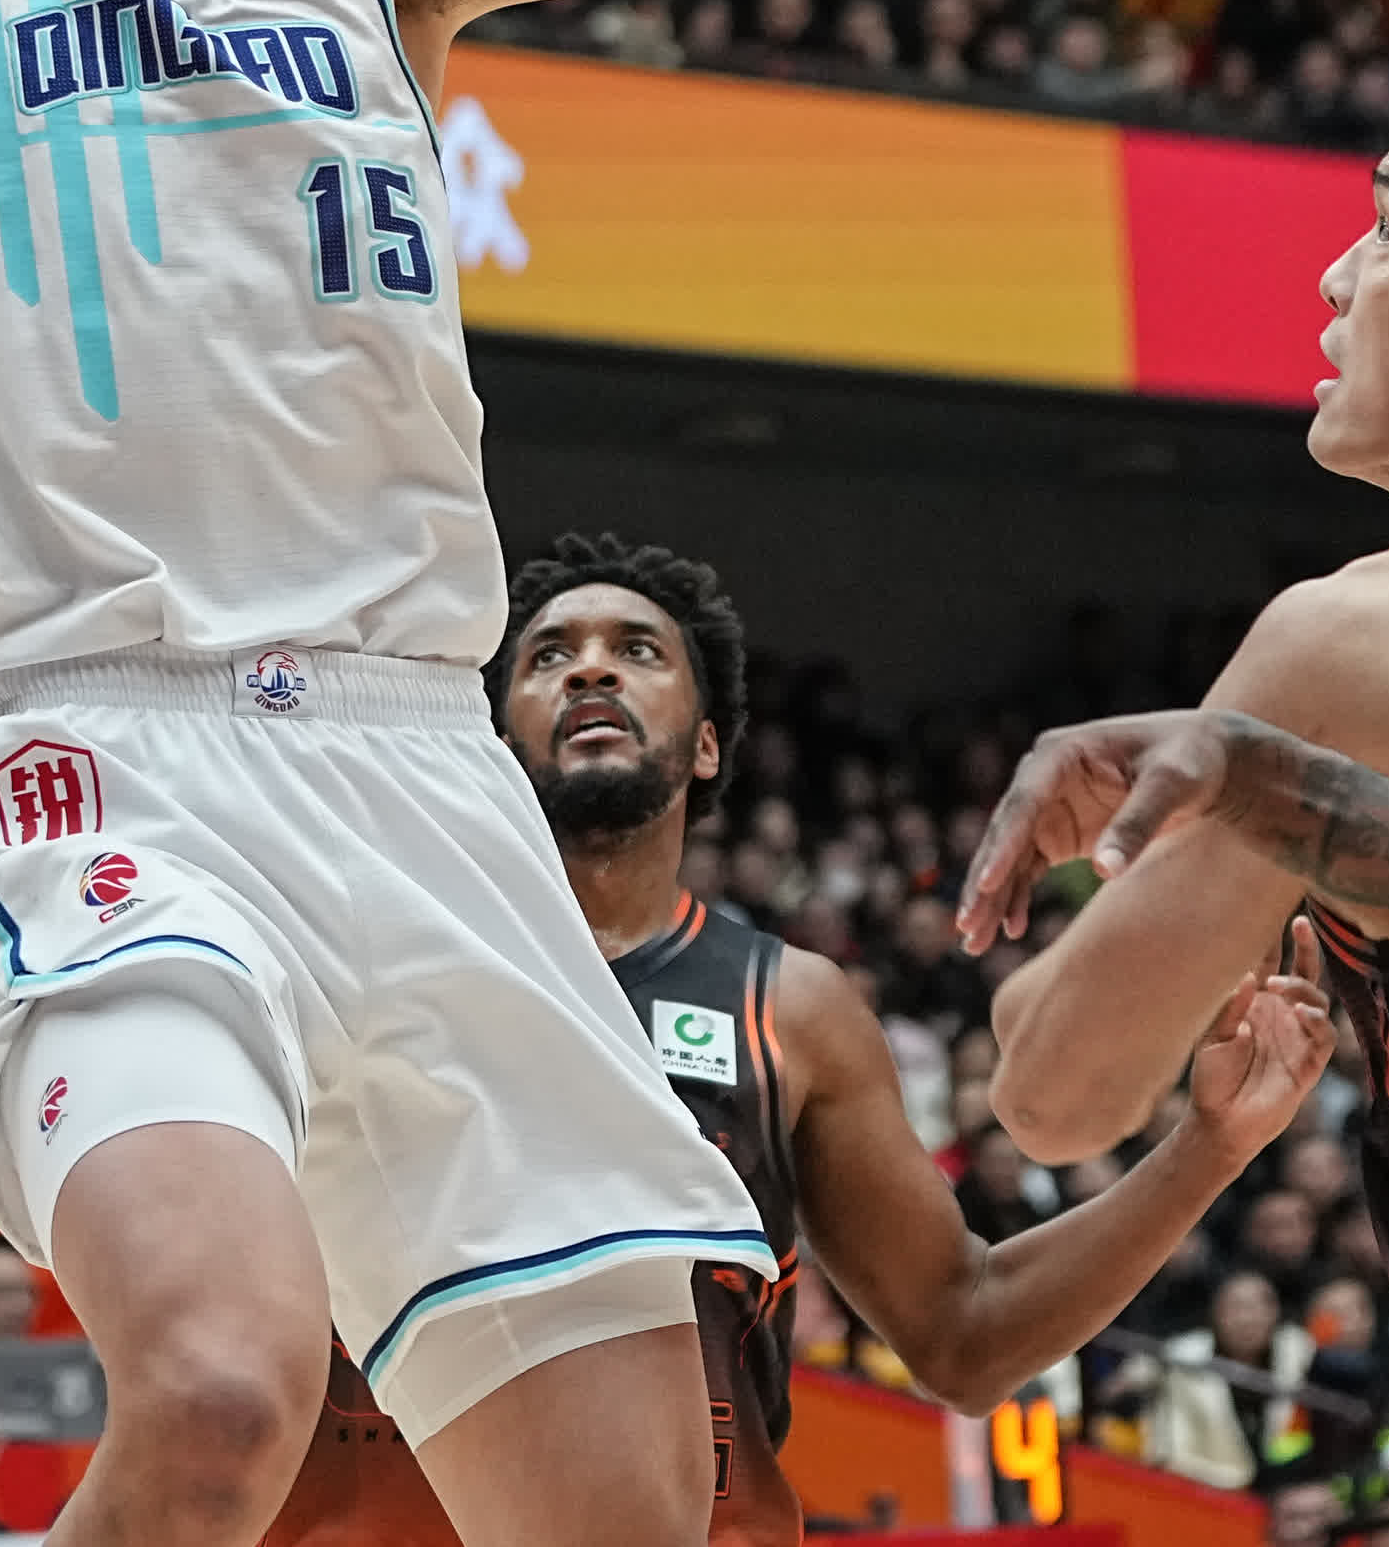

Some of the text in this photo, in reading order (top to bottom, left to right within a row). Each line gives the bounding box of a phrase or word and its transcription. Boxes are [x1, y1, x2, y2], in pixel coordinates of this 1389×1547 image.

[299, 157, 437, 302] 15
[254, 693, 301, 713] QINGDAO
[99, 897, 148, 924] CBA
[991, 1396, 1063, 1526] 4
